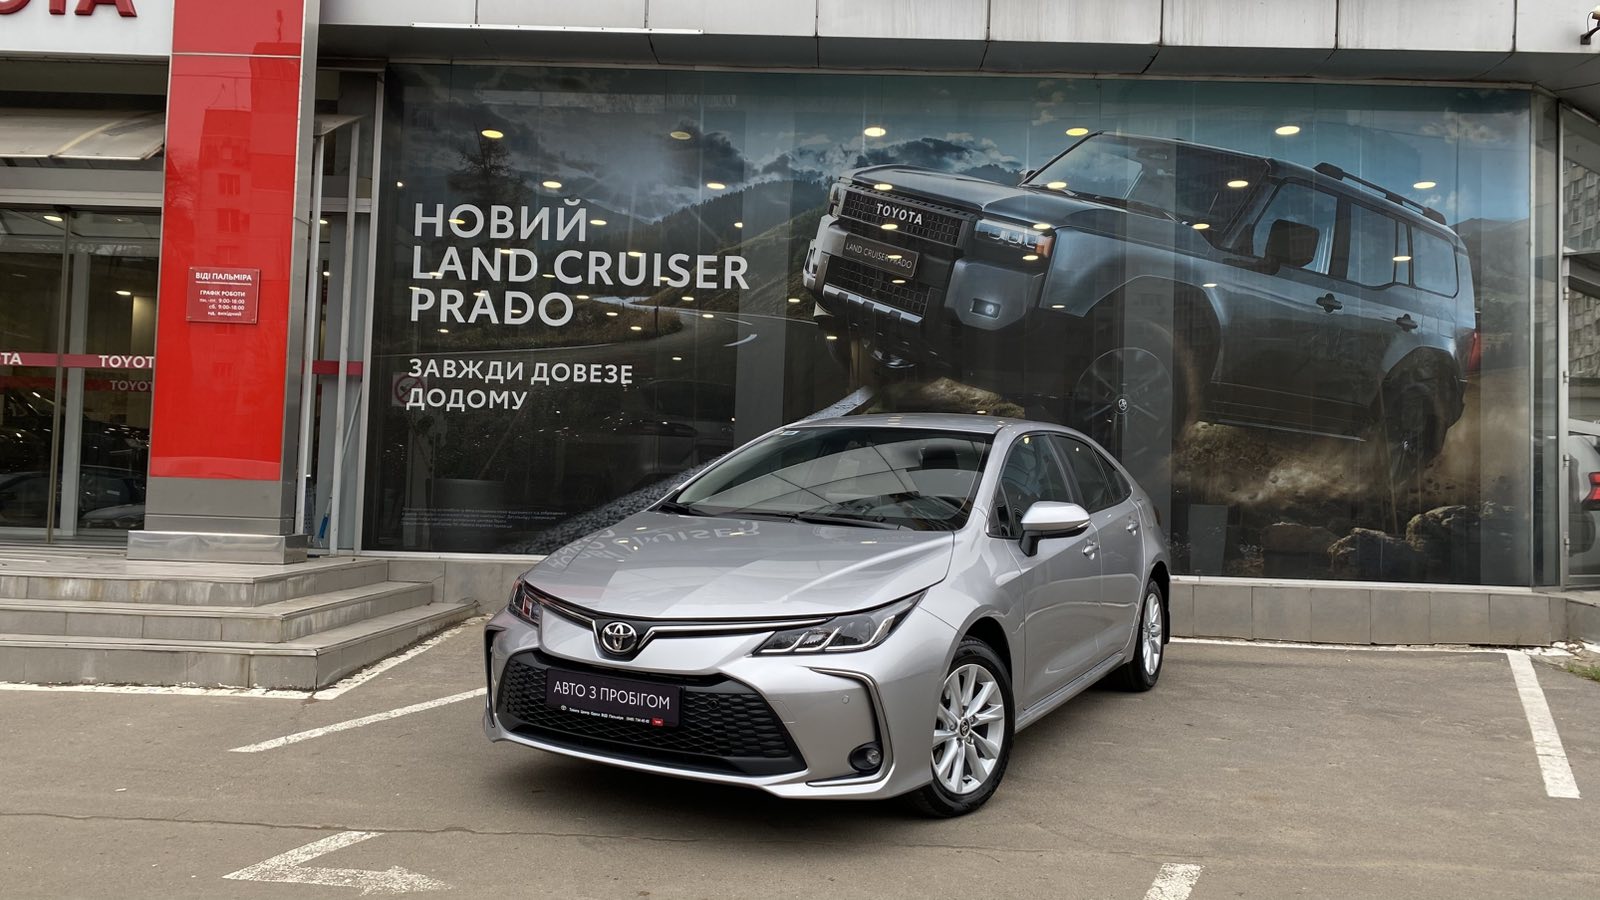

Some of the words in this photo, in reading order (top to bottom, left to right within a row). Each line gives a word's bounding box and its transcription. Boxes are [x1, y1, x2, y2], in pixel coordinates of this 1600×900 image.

[414, 198, 588, 242] НОВИЙ
[876, 203, 922, 225] TOYOTA
[846, 243, 863, 254] LAND
[195, 272, 211, 281] ВІДІ
[212, 272, 252, 281] ПАЛЬМІРА
[412, 245, 538, 283] LAND
[553, 249, 750, 290] CRUISER
[410, 288, 574, 327] PRADO
[0, 352, 22, 365] TA
[98, 355, 155, 368] TOYOT
[408, 358, 524, 383] ЗАВЖДИ
[531, 362, 633, 385] ДОВЕЗЕ
[110, 380, 153, 391] TOYO
[406, 388, 528, 412] ДОДОМУ
[553, 681, 586, 698] АВТО
[588, 686, 597, 699] З
[600, 687, 670, 710] ПРОБІГОМ
